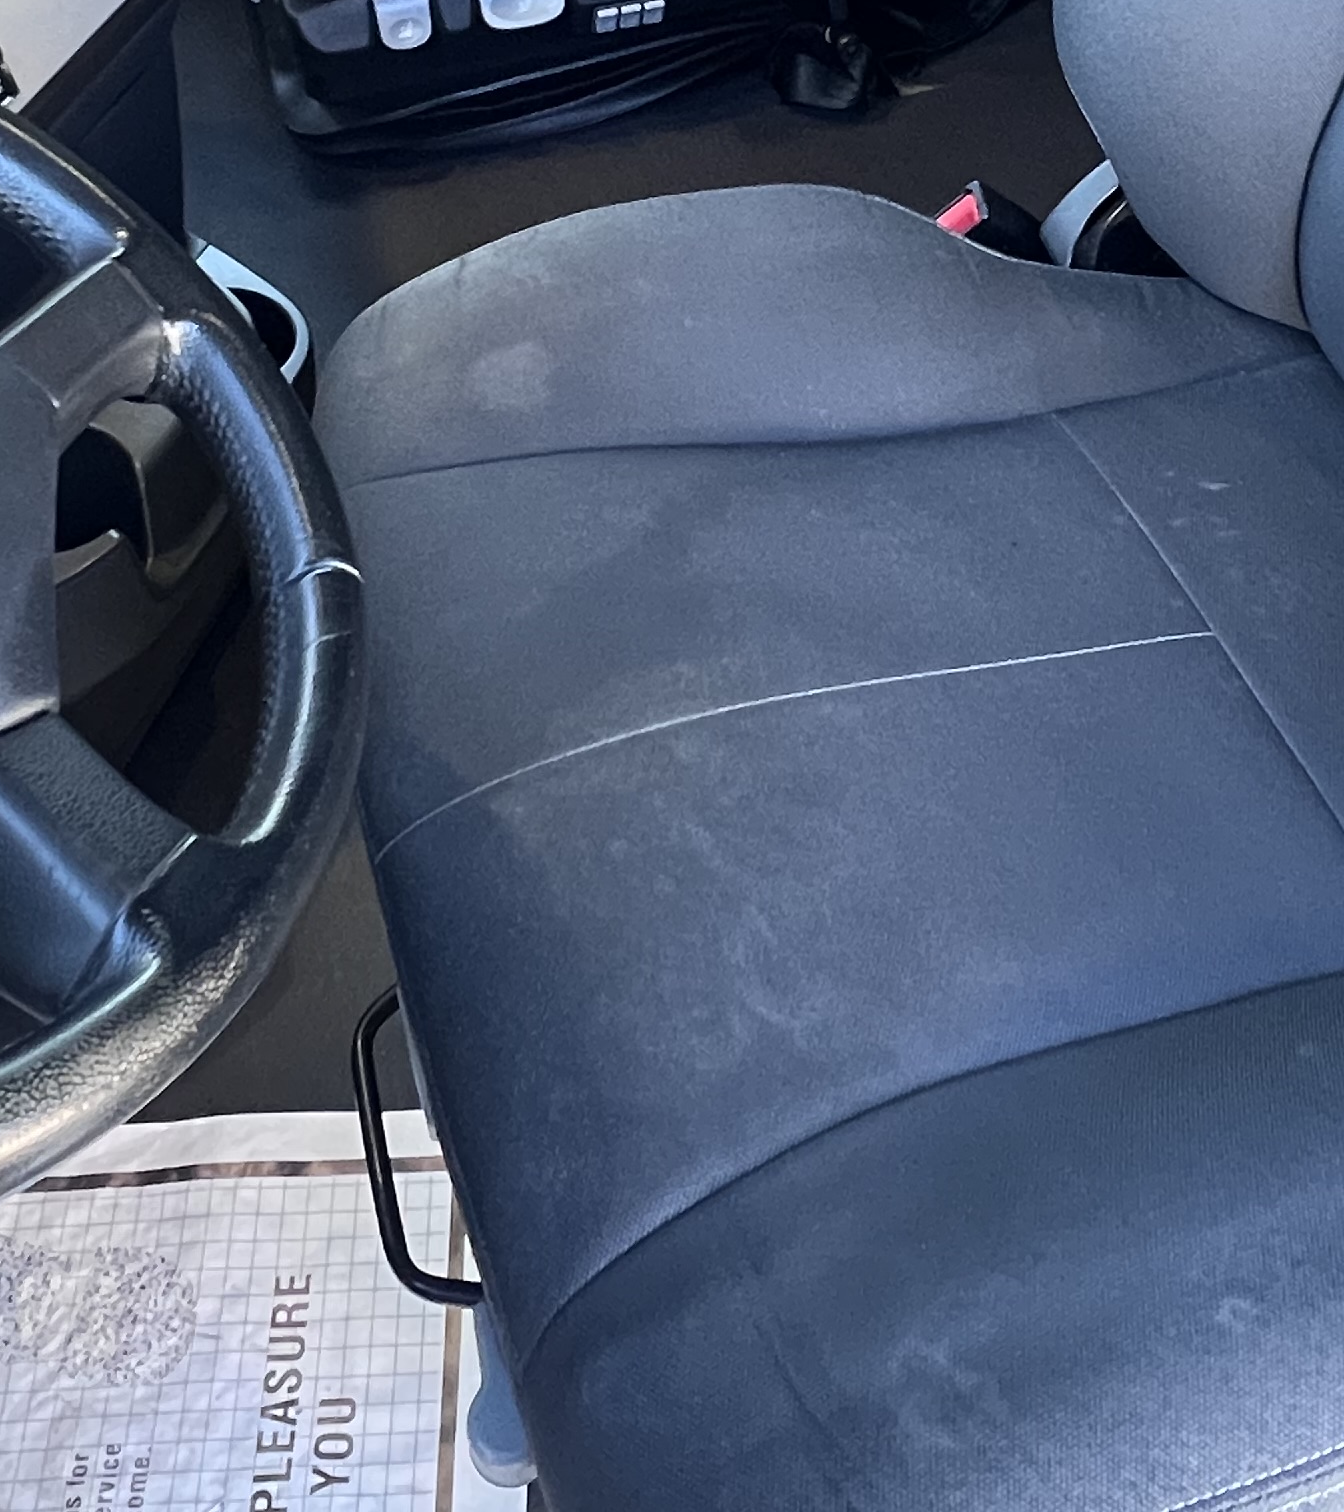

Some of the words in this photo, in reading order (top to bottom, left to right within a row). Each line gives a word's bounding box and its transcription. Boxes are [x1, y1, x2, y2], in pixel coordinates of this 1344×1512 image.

[250, 1273, 312, 1512] PLEASURE
[65, 1453, 89, 1486] for
[310, 1396, 357, 1494] YOU
